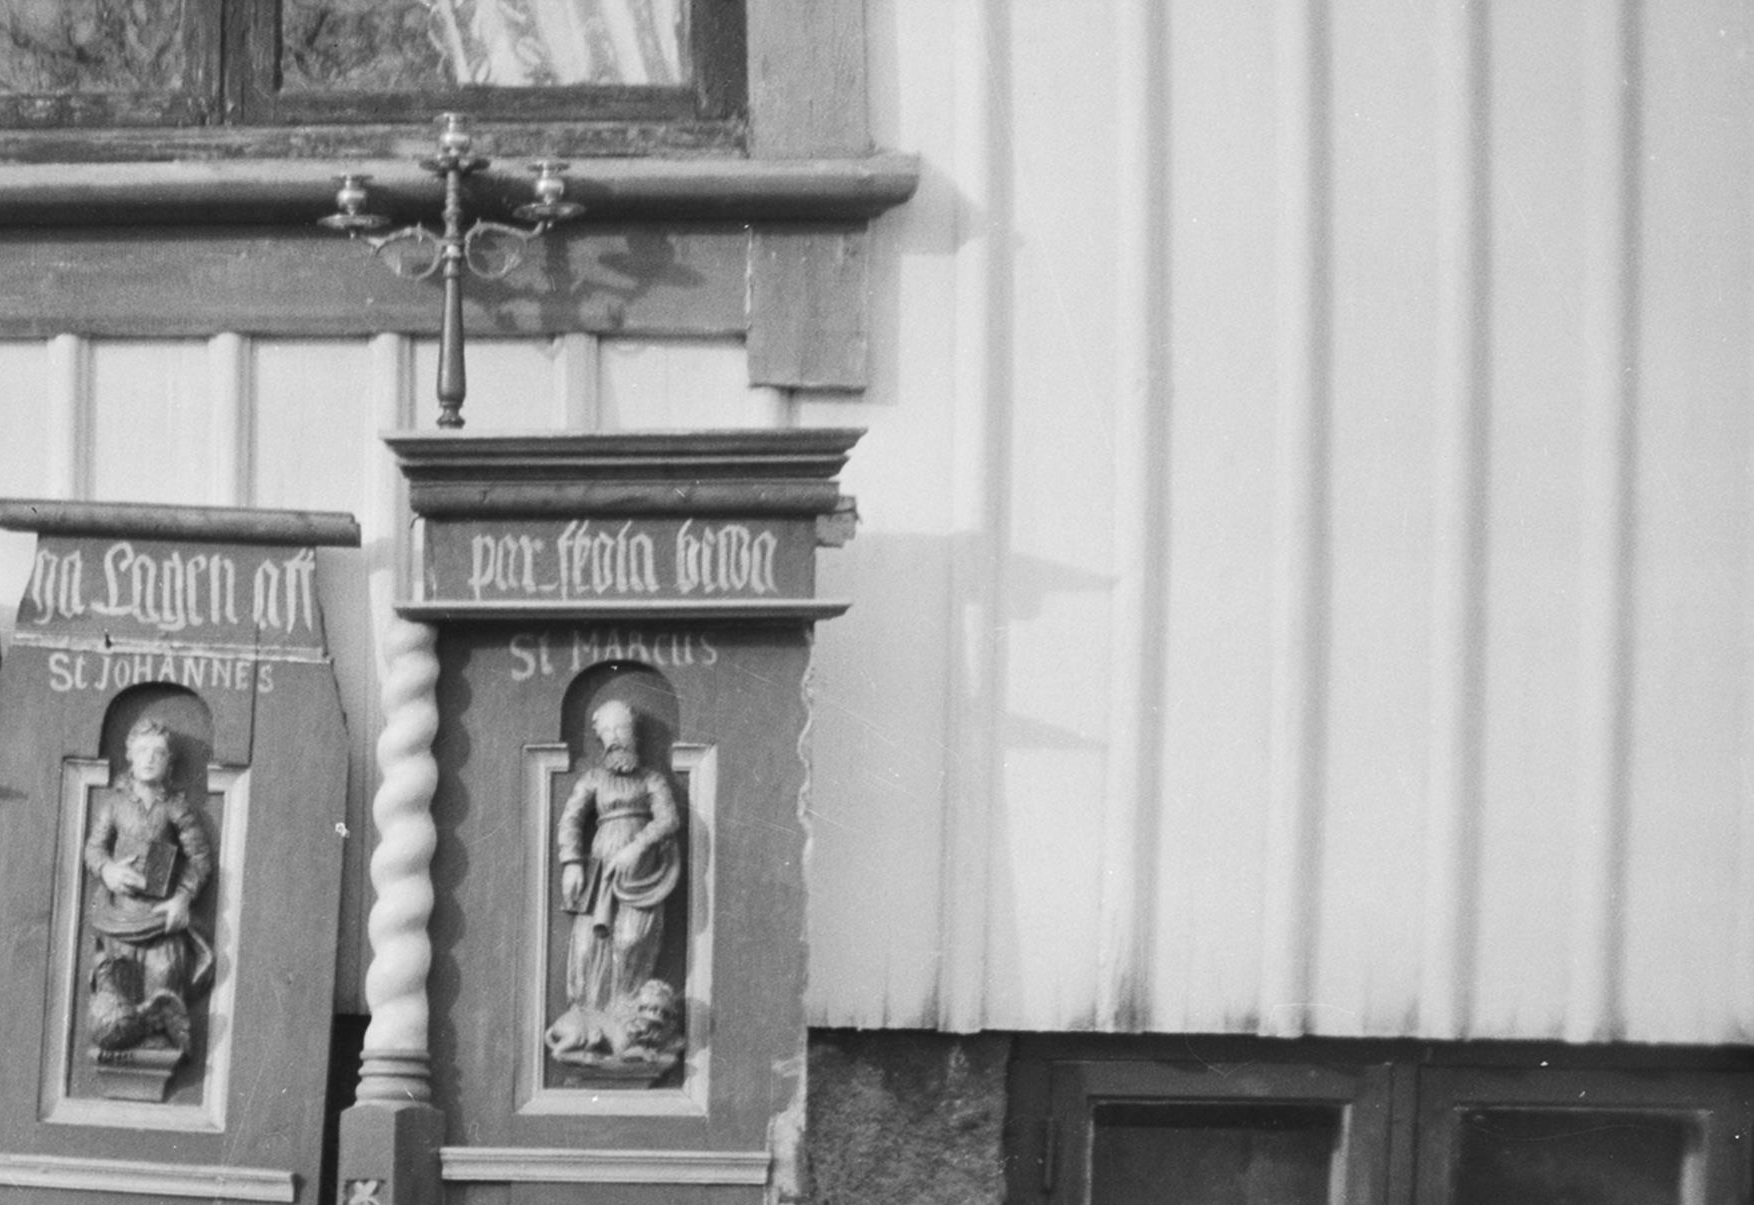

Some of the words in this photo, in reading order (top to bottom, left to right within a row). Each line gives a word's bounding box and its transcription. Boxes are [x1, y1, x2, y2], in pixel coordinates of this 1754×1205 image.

[569, 629, 719, 673] MARCUS
[48, 652, 88, 692] St
[94, 656, 274, 693] JOHANNES
